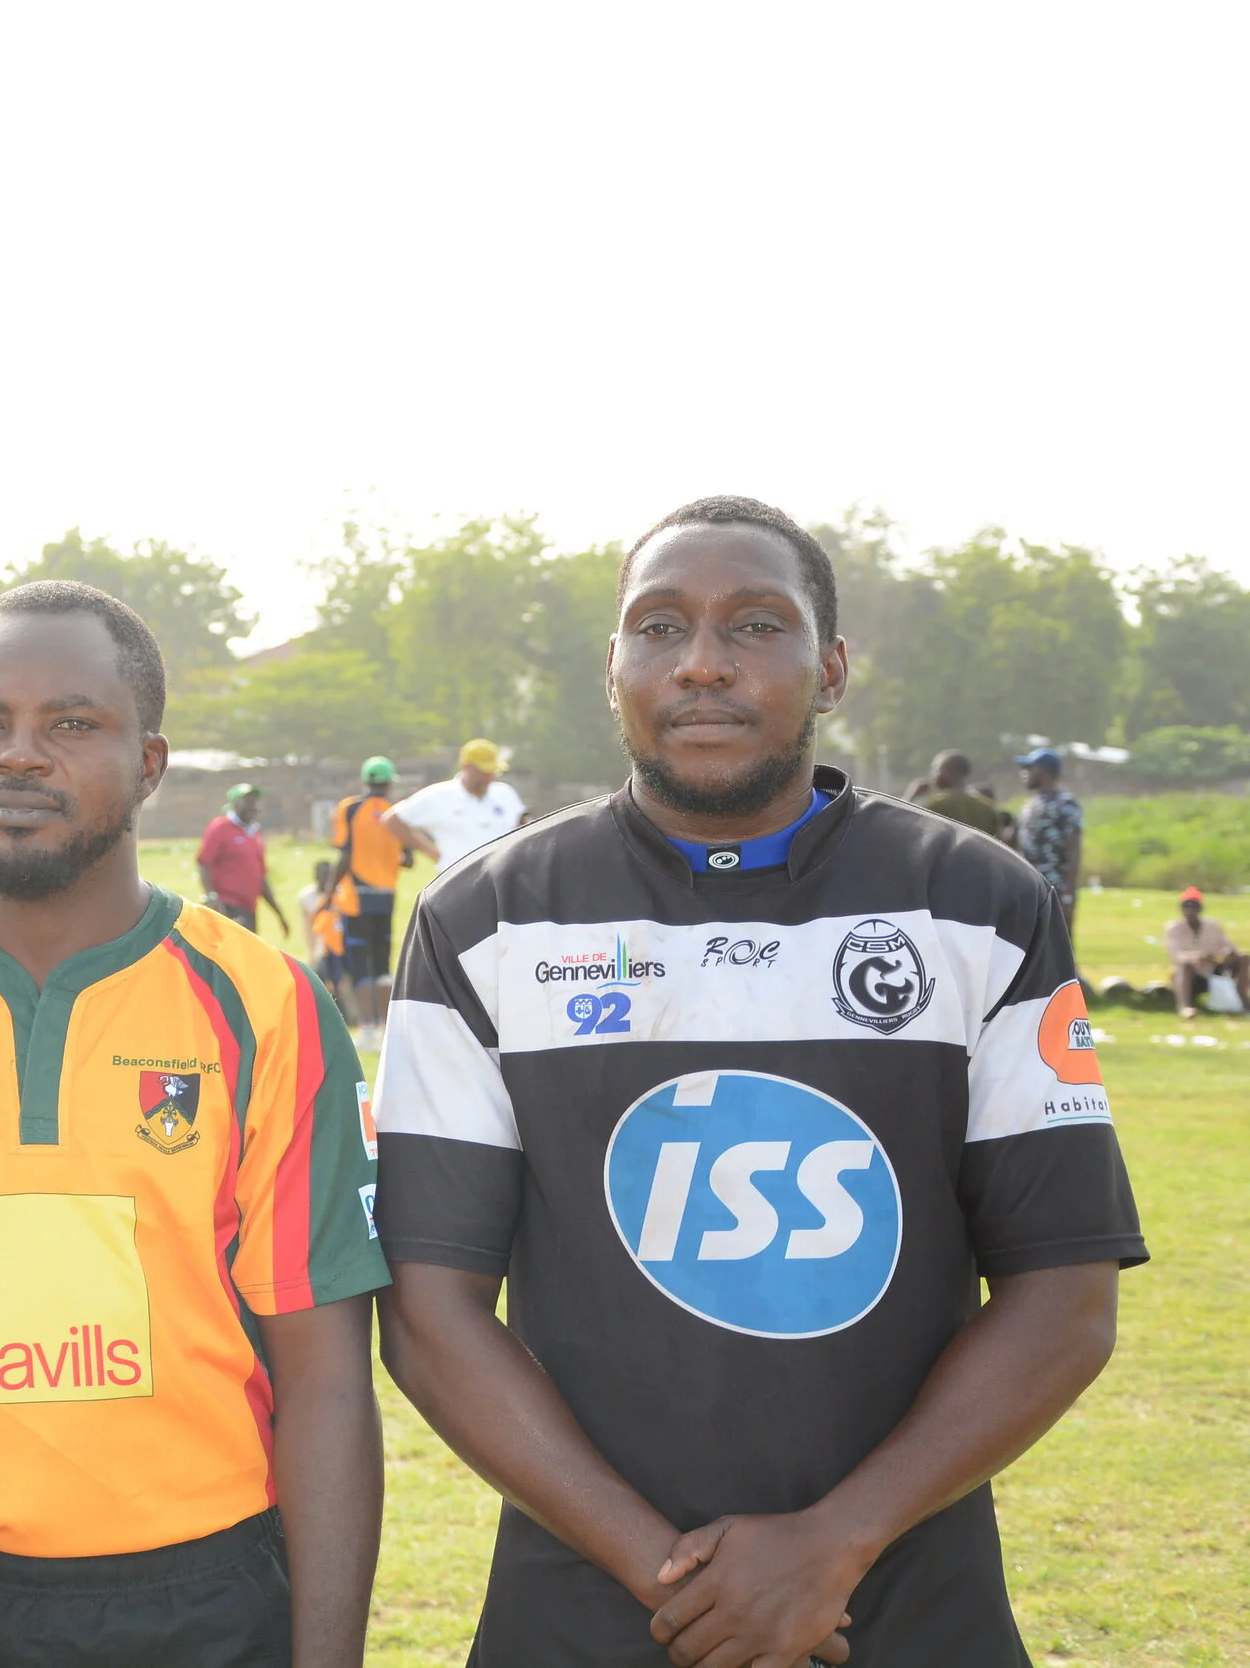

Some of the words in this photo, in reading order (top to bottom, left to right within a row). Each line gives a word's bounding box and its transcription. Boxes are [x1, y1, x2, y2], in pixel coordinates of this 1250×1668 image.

[704, 937, 780, 965] ROC
[846, 936, 906, 952] CSM
[535, 935, 666, 983] Gennevilliers
[561, 954, 589, 963] VILLE
[592, 952, 607, 962] DE
[567, 992, 631, 1036] 92
[112, 1055, 197, 1070] Beaconsfield
[200, 1062, 221, 1074] RFC
